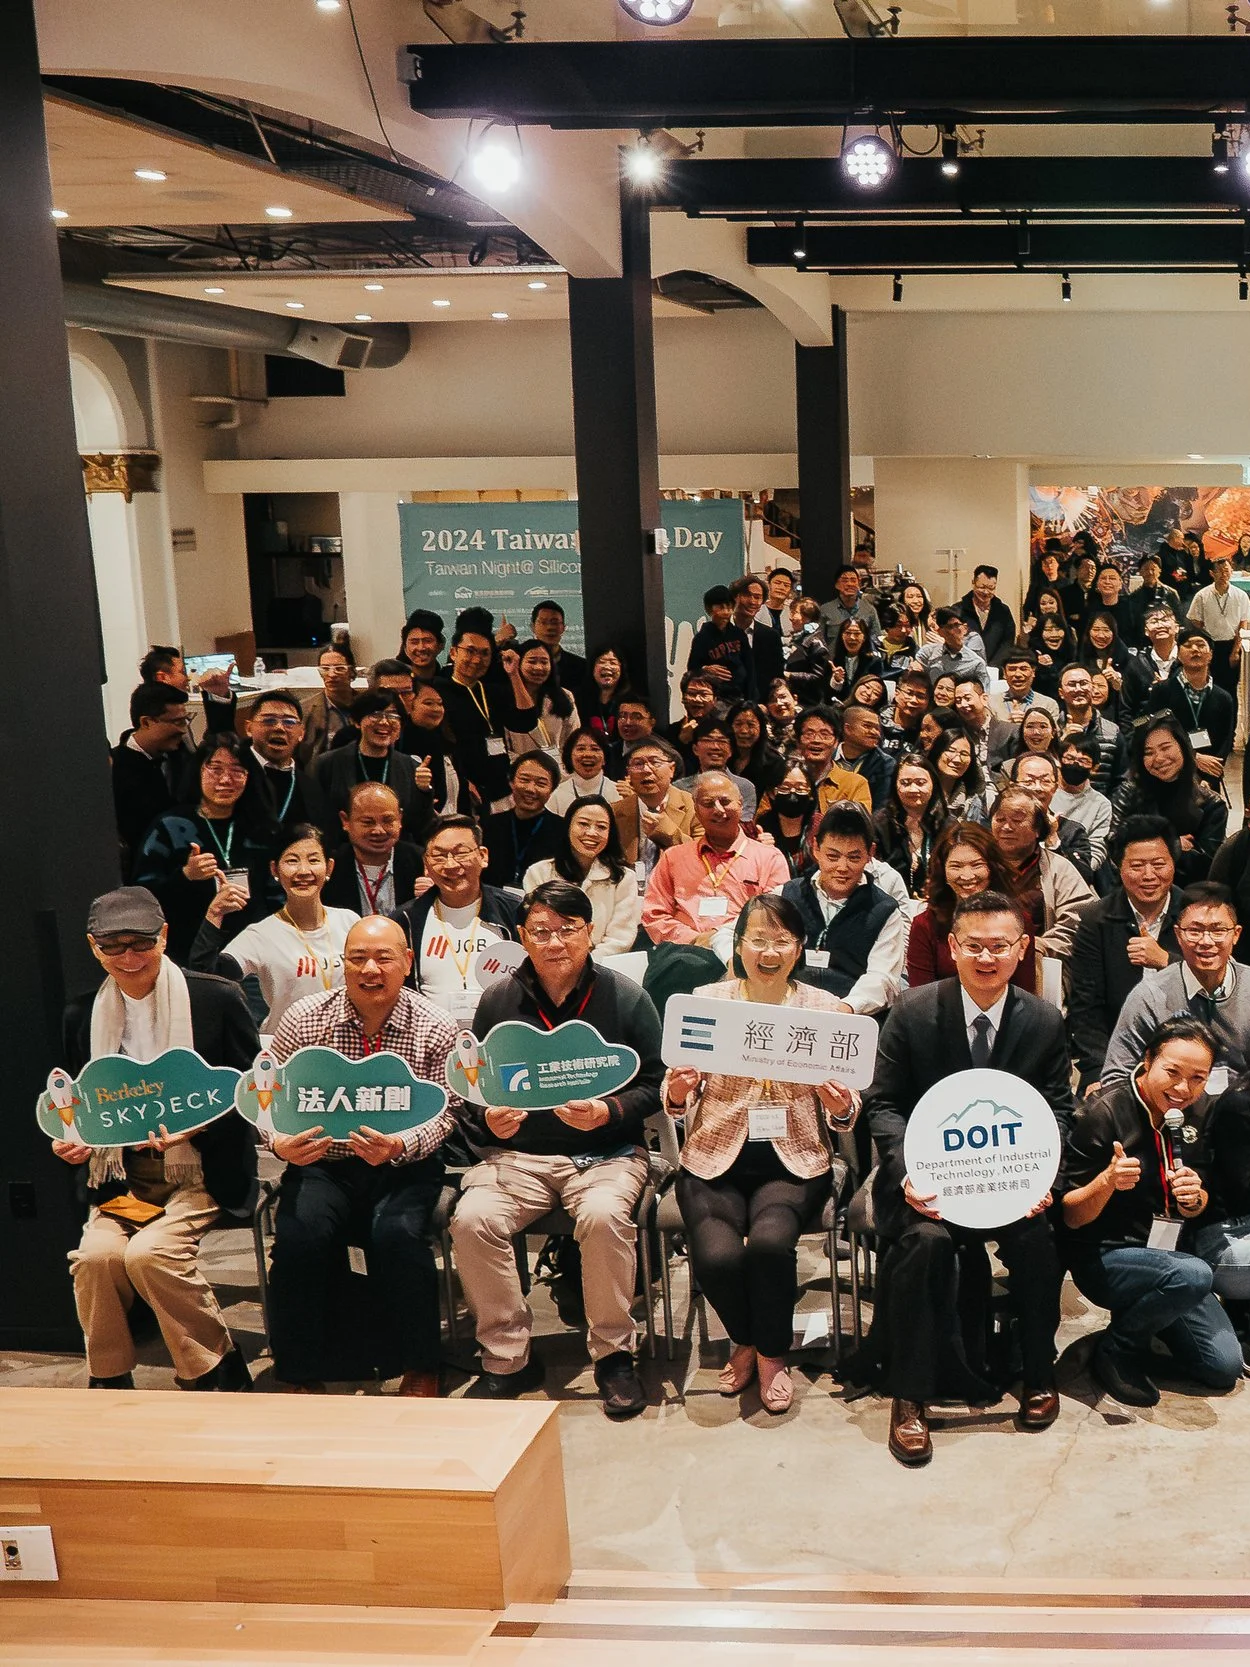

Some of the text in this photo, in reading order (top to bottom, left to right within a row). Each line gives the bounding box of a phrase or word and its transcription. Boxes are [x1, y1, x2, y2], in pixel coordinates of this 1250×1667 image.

[421, 529, 487, 551] 2024
[673, 526, 723, 554] Day
[424, 560, 478, 576] Taiwan
[455, 938, 487, 954] JGB
[743, 1019, 860, 1061] 經濟部
[742, 1054, 775, 1066] Ministry
[787, 1059, 828, 1071] Economic
[829, 1064, 857, 1075] Affairs
[94, 1078, 165, 1105] Berkeley
[297, 1085, 412, 1112] 法人新創
[943, 1121, 1023, 1152] DOIT
[915, 1148, 1052, 1171] Department of Industrial
[1002, 1162, 1040, 1175] MOEA
